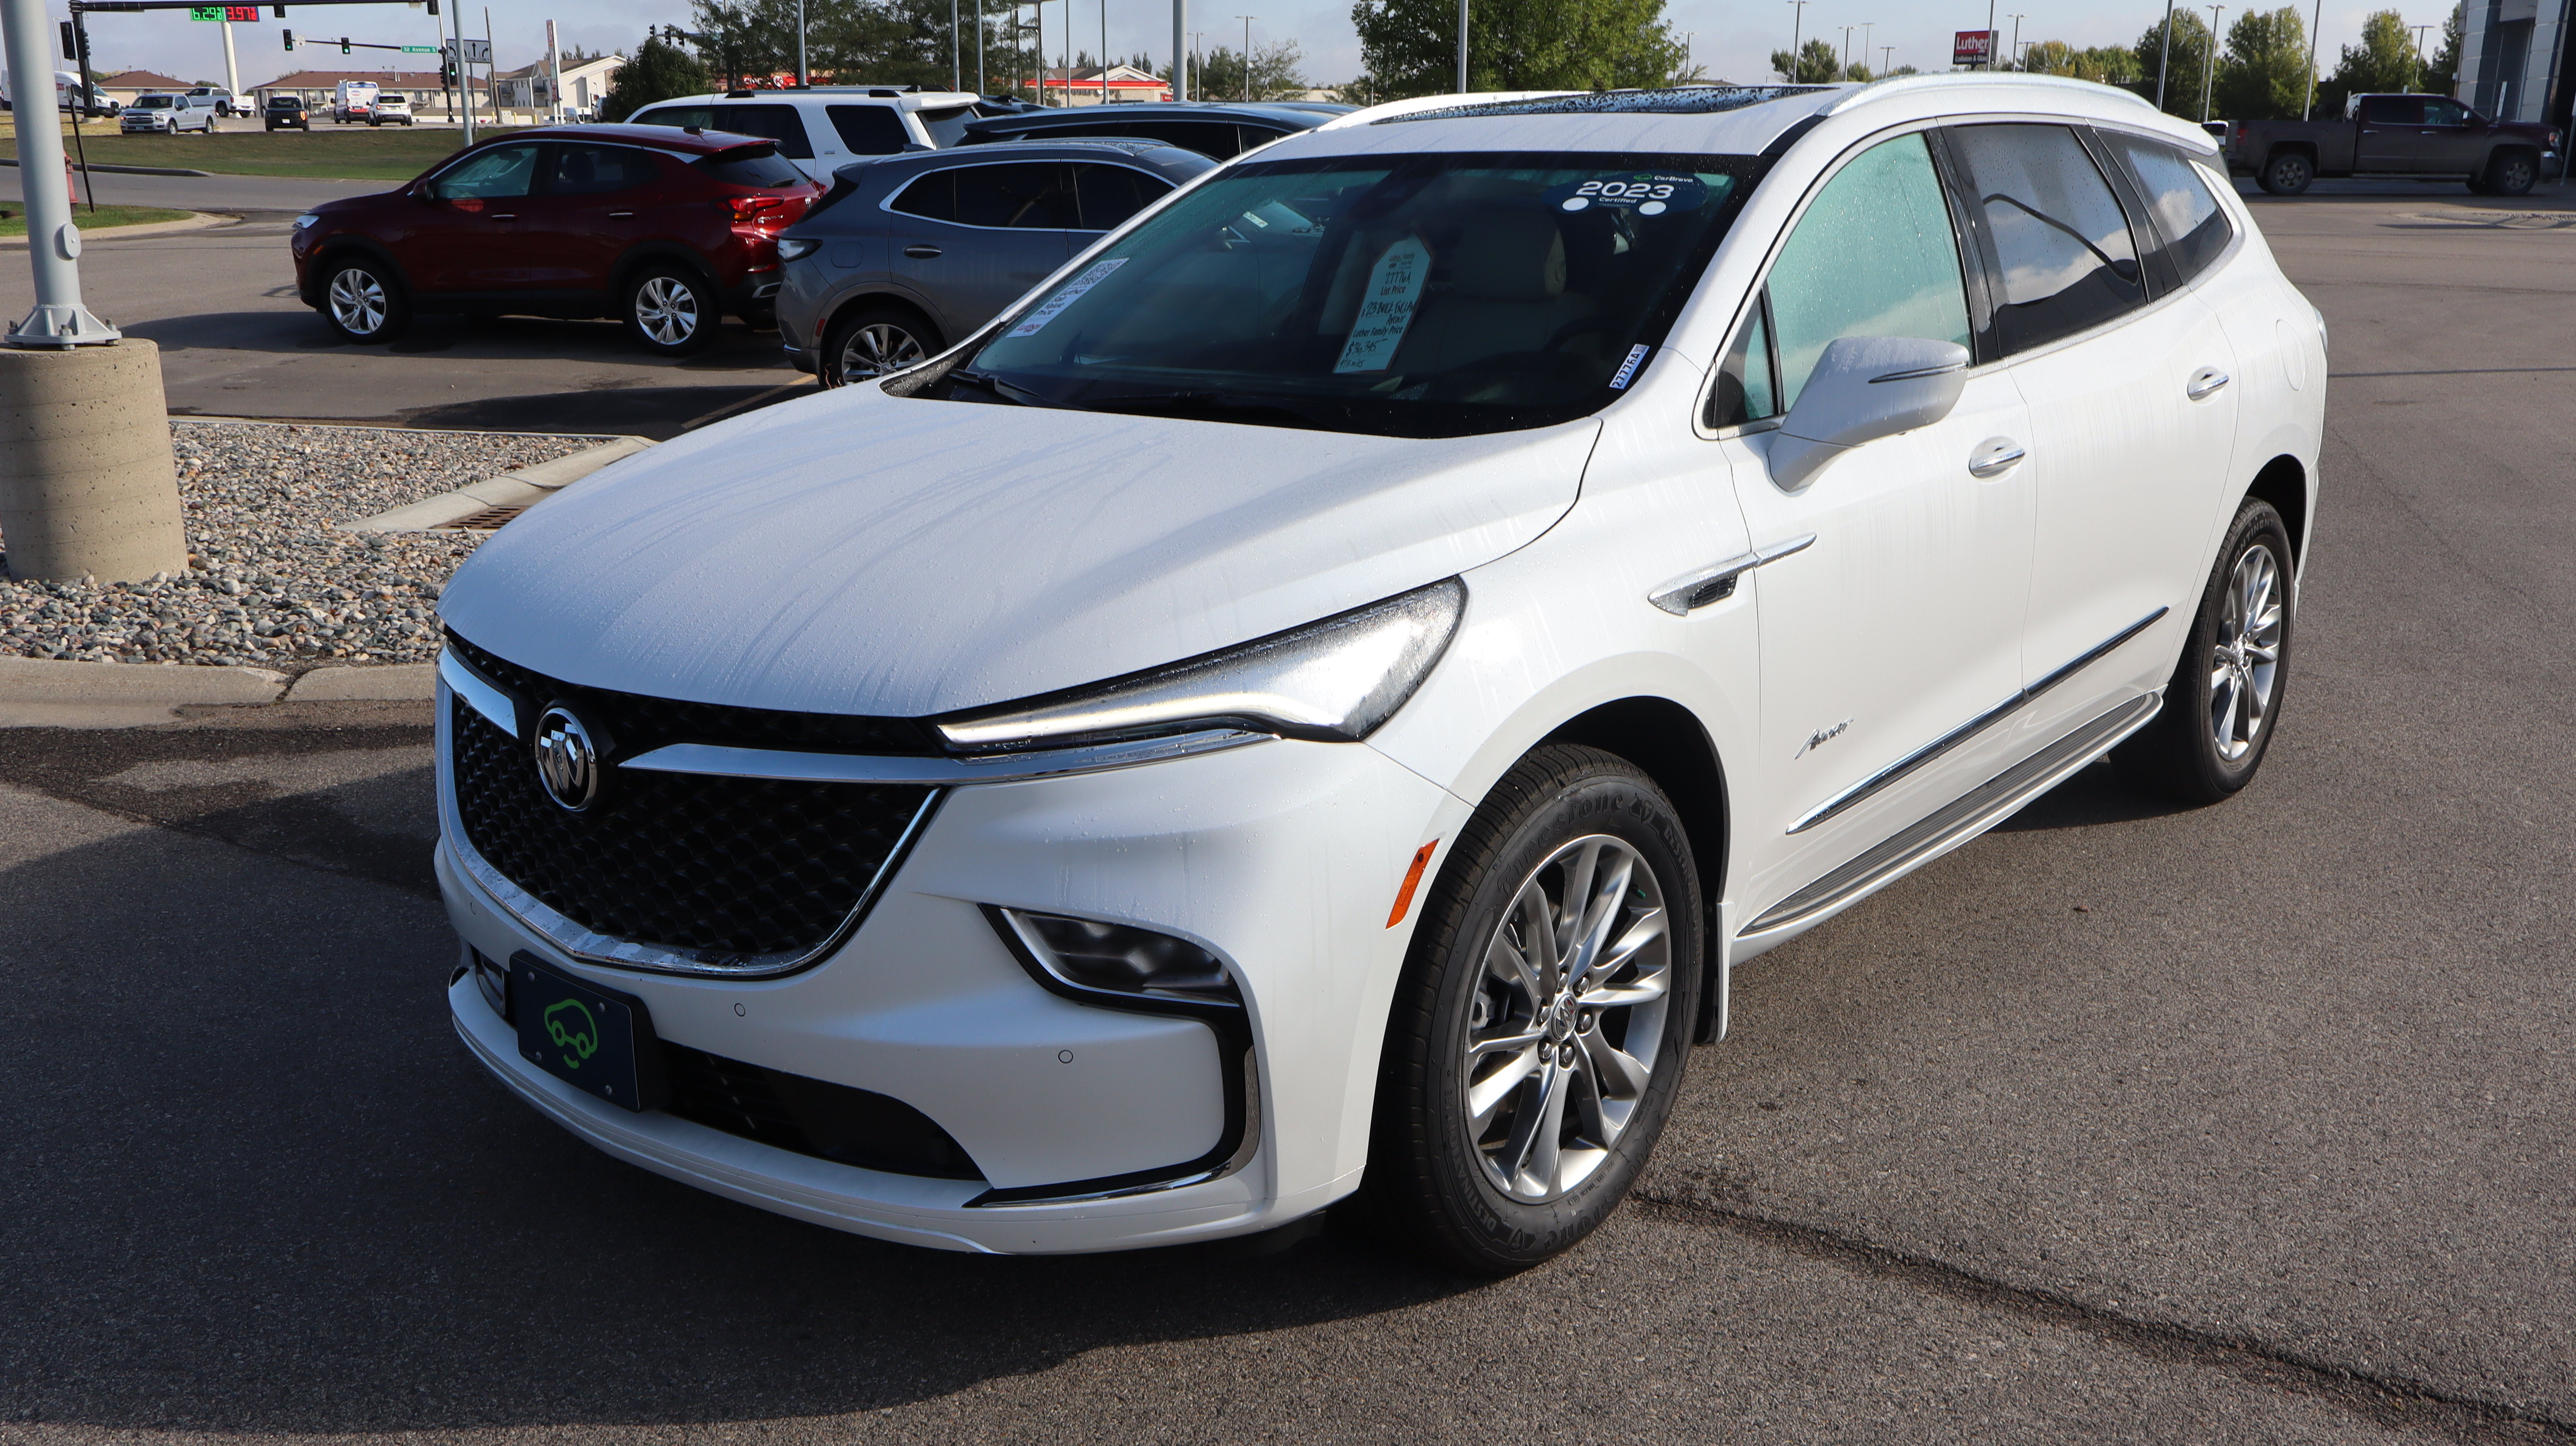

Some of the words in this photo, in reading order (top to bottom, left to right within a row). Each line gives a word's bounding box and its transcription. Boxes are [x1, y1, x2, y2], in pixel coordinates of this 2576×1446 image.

[227, 7, 250, 20] 3.97
[1956, 36, 1989, 50] Luther
[1654, 175, 1693, 183] CarBrave
[1576, 181, 1674, 199] 2023
[1381, 286, 1391, 296] List
[1391, 285, 1406, 295] Price
[1353, 329, 1370, 338] Luther
[1371, 327, 1388, 337] Family
[1389, 325, 1403, 335] Price
[1612, 353, 1640, 387] 27776A
[1497, 793, 1623, 897] Firestone
